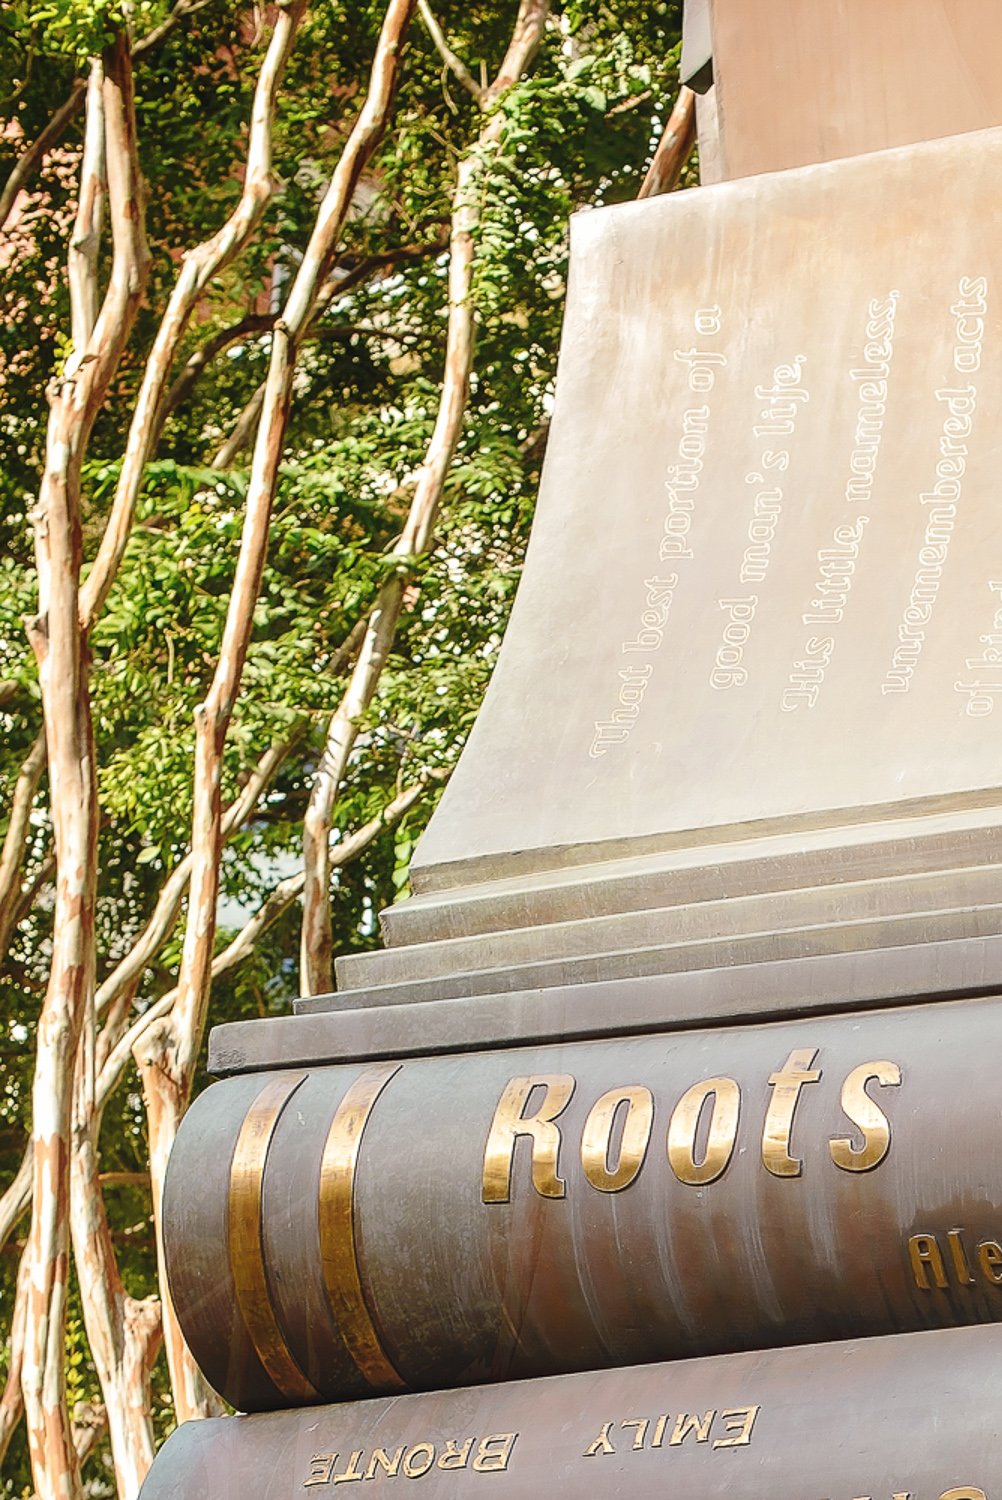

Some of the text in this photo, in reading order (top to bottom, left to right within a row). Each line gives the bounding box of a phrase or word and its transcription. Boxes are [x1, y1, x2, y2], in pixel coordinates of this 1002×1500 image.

[588, 306, 727, 757] That best portion of a
[781, 289, 900, 712] His little, nameless,
[880, 275, 989, 694] unremembered acts
[707, 596, 759, 691] good
[482, 1047, 903, 1203] Roots
[303, 1405, 760, 1487] EMILY BRONTE
